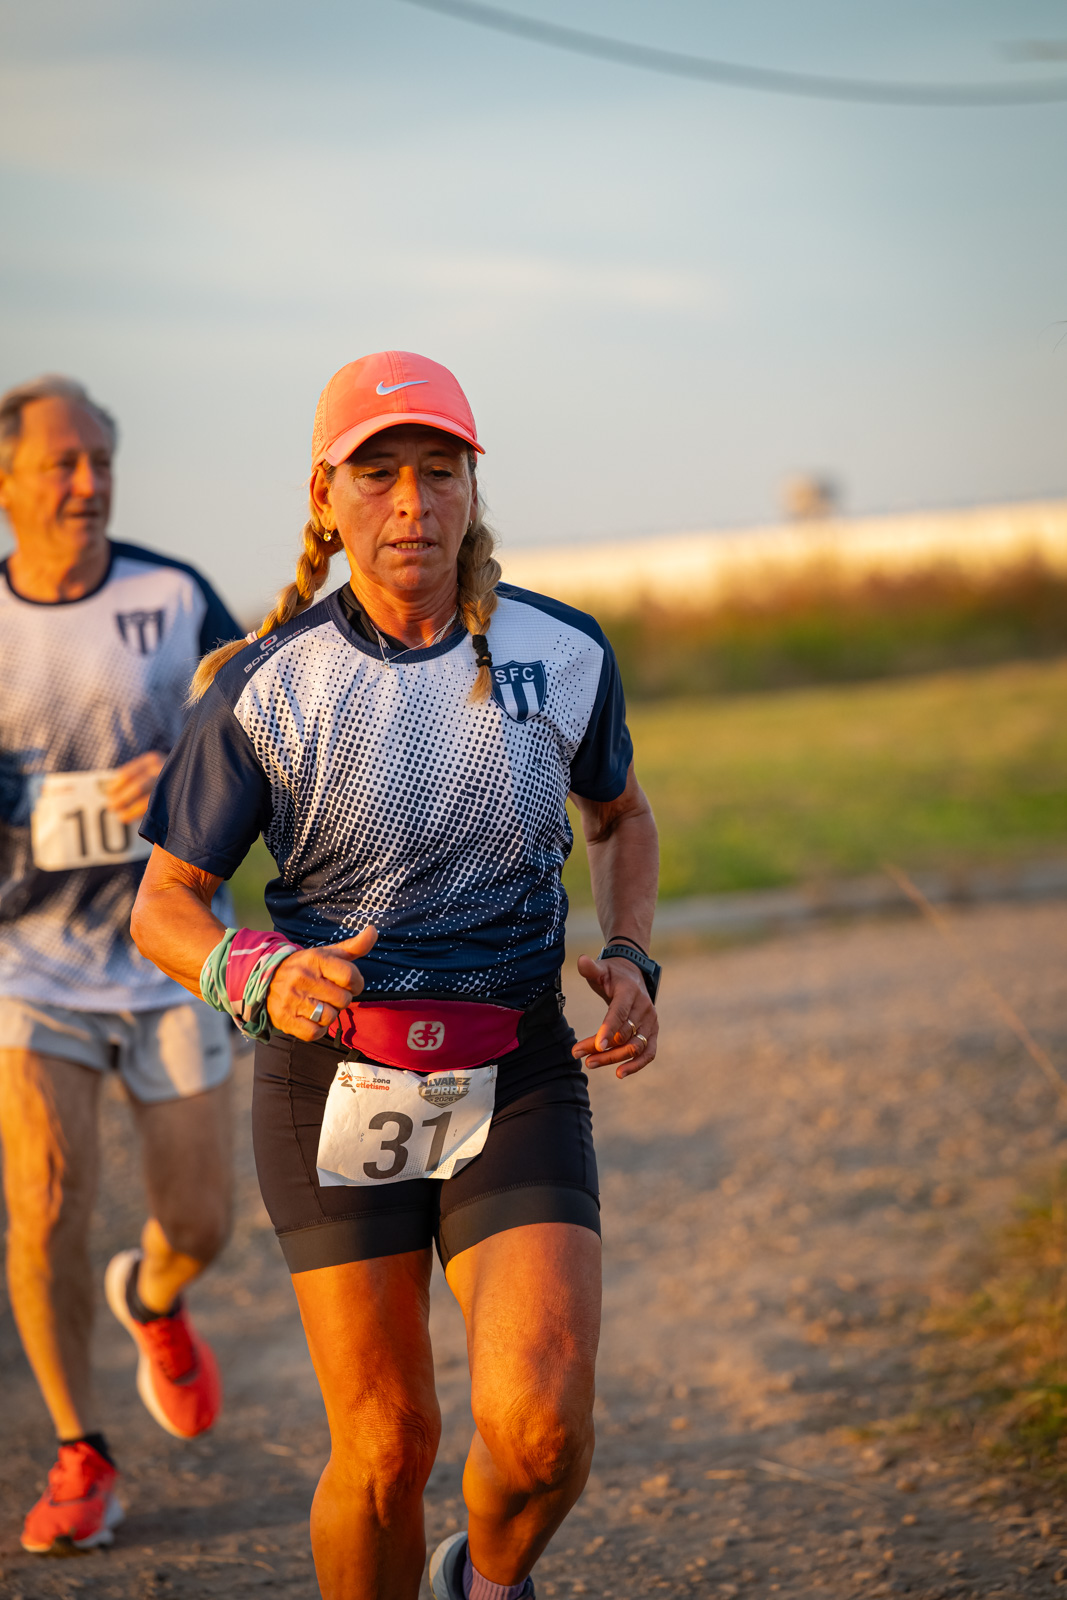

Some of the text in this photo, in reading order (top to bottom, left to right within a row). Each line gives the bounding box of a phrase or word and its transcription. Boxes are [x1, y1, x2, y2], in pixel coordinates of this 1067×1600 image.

[494, 667, 535, 683] SFC
[355, 1081, 390, 1091] atletismo
[372, 1077, 391, 1085] zona
[421, 1085, 471, 1097] CORRE
[362, 1110, 453, 1180] 31
